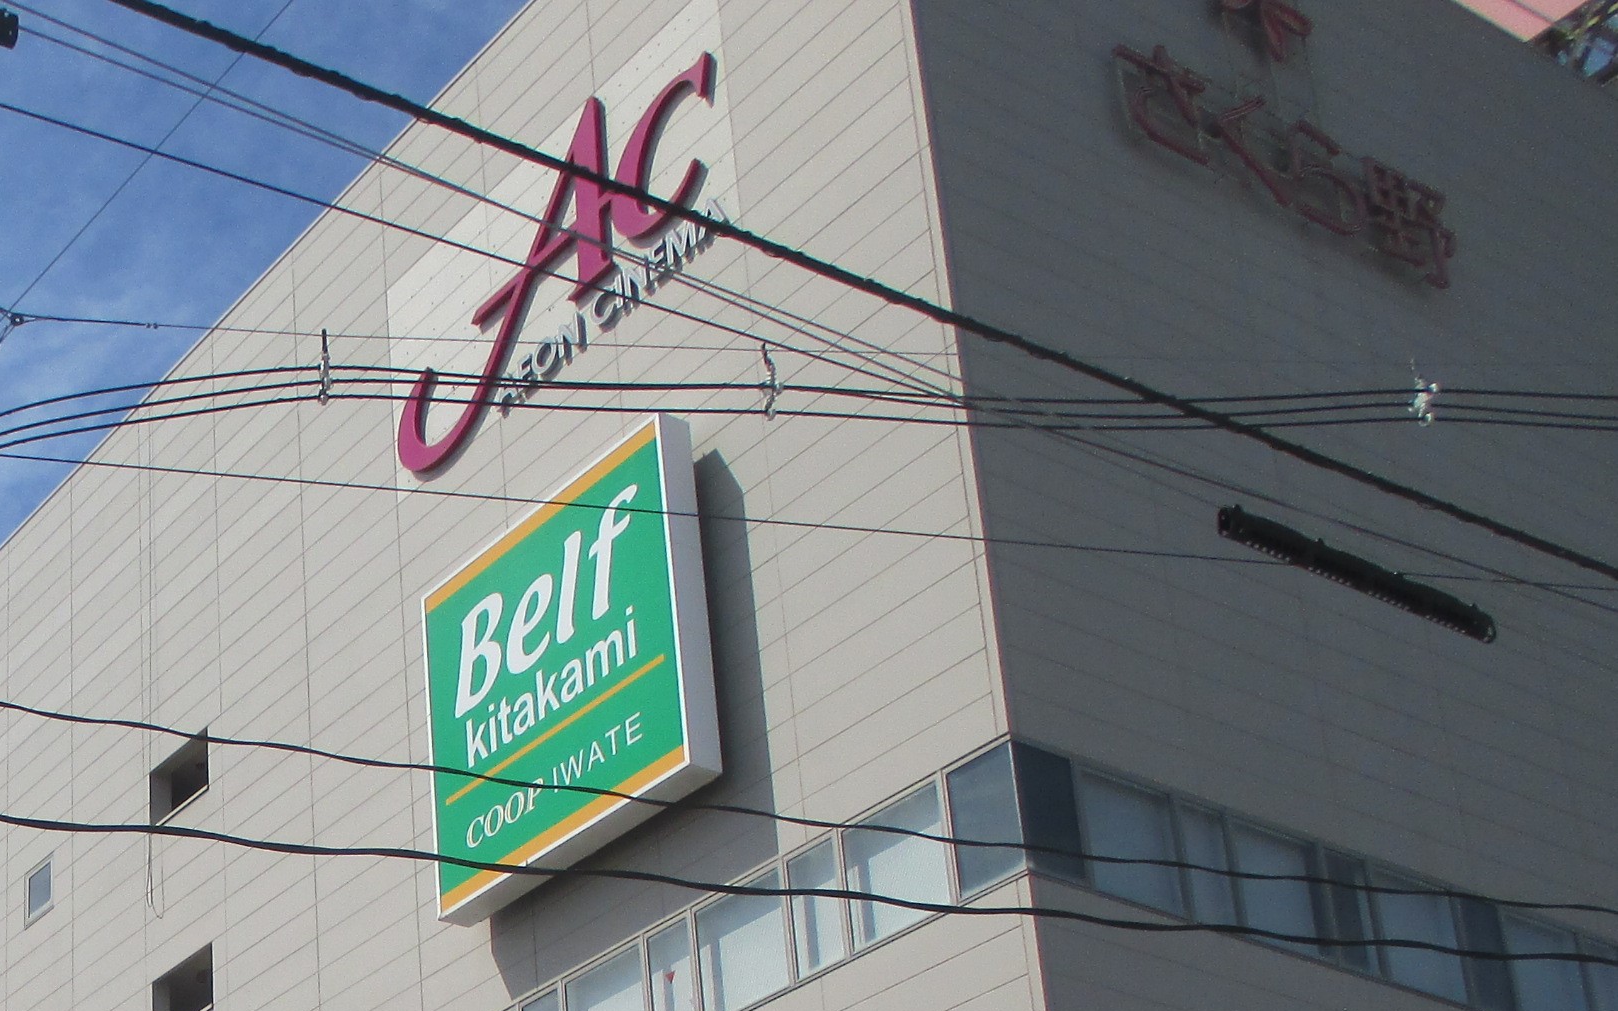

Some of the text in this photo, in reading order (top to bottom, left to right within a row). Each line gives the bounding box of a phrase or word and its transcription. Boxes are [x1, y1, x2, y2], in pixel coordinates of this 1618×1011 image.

[398, 51, 717, 474] JAC
[590, 198, 731, 326] CINEMA
[454, 483, 639, 719] Belf
[466, 606, 638, 769] kitakami
[466, 711, 643, 849] COOP IWATE
